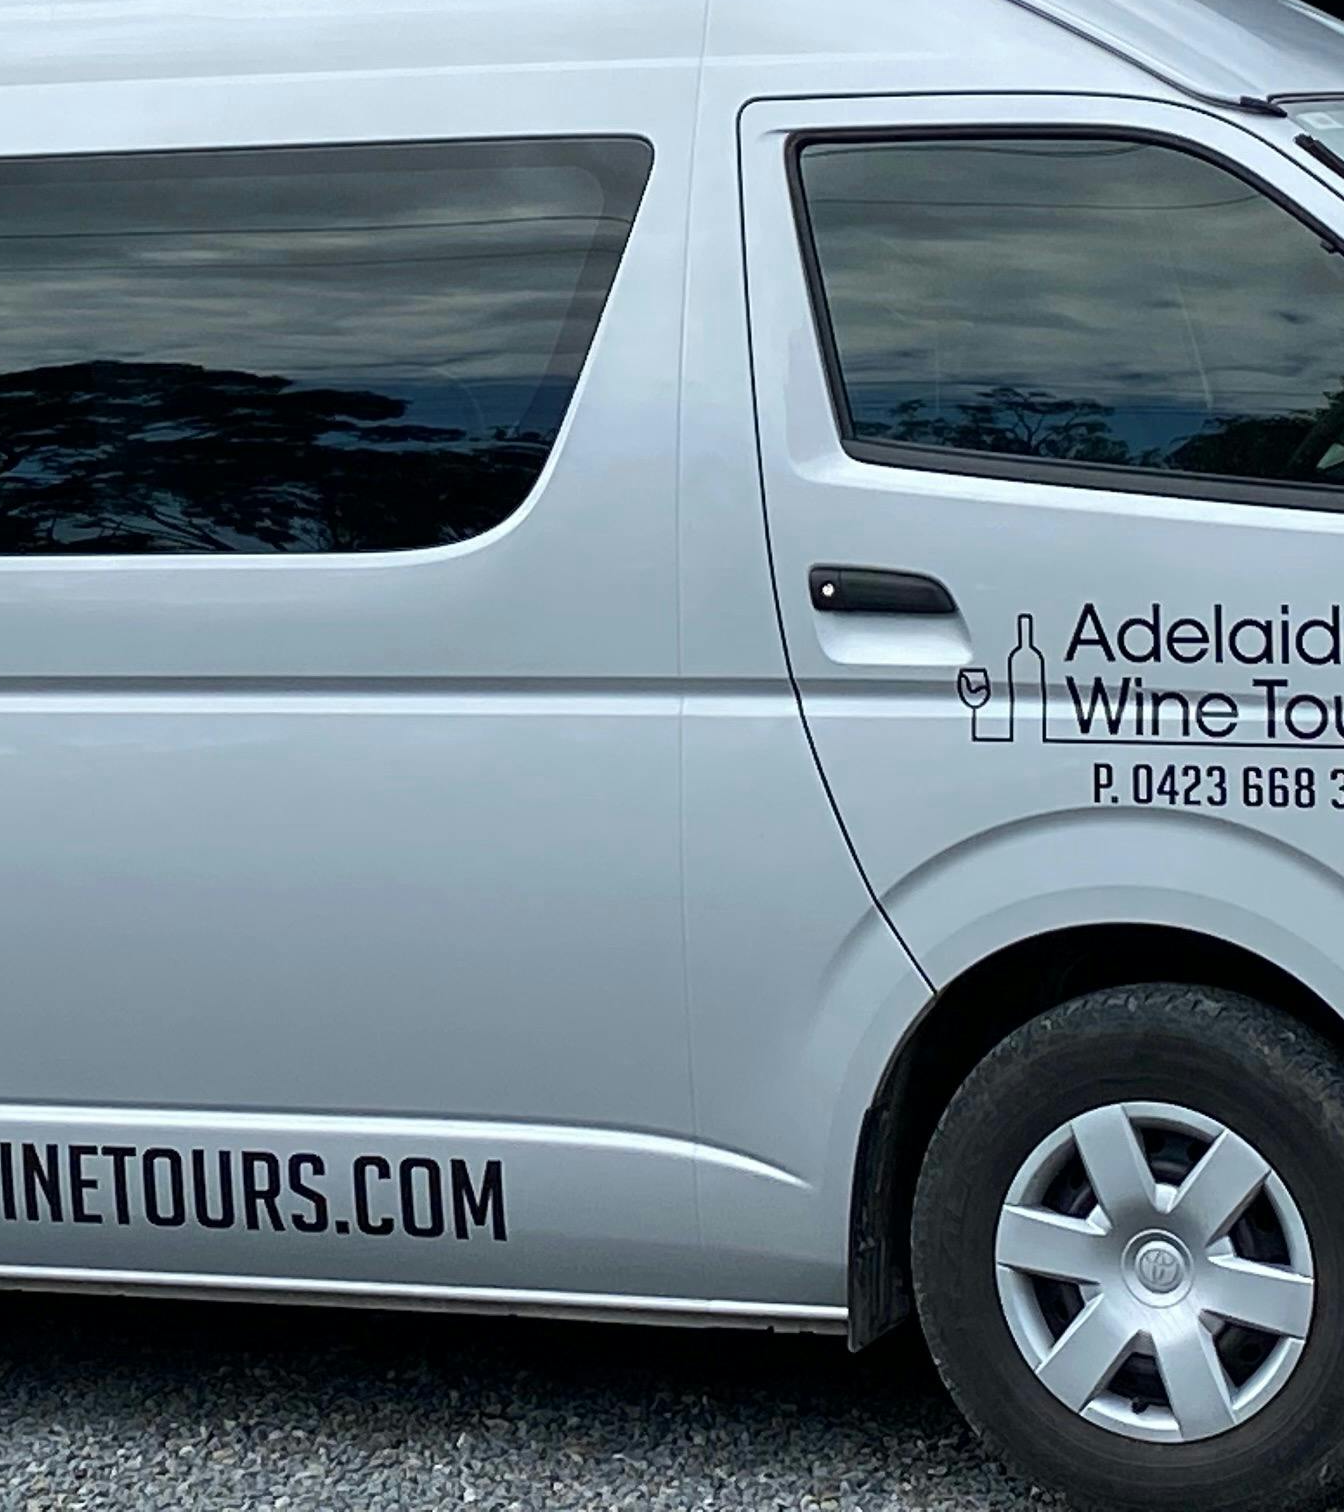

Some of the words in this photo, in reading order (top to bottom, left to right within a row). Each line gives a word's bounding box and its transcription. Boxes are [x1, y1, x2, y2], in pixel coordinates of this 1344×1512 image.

[1065, 675, 1239, 738] Wine
[1093, 763, 1119, 805] P.
[1132, 764, 1227, 806] 0423
[1242, 767, 1316, 809] 668
